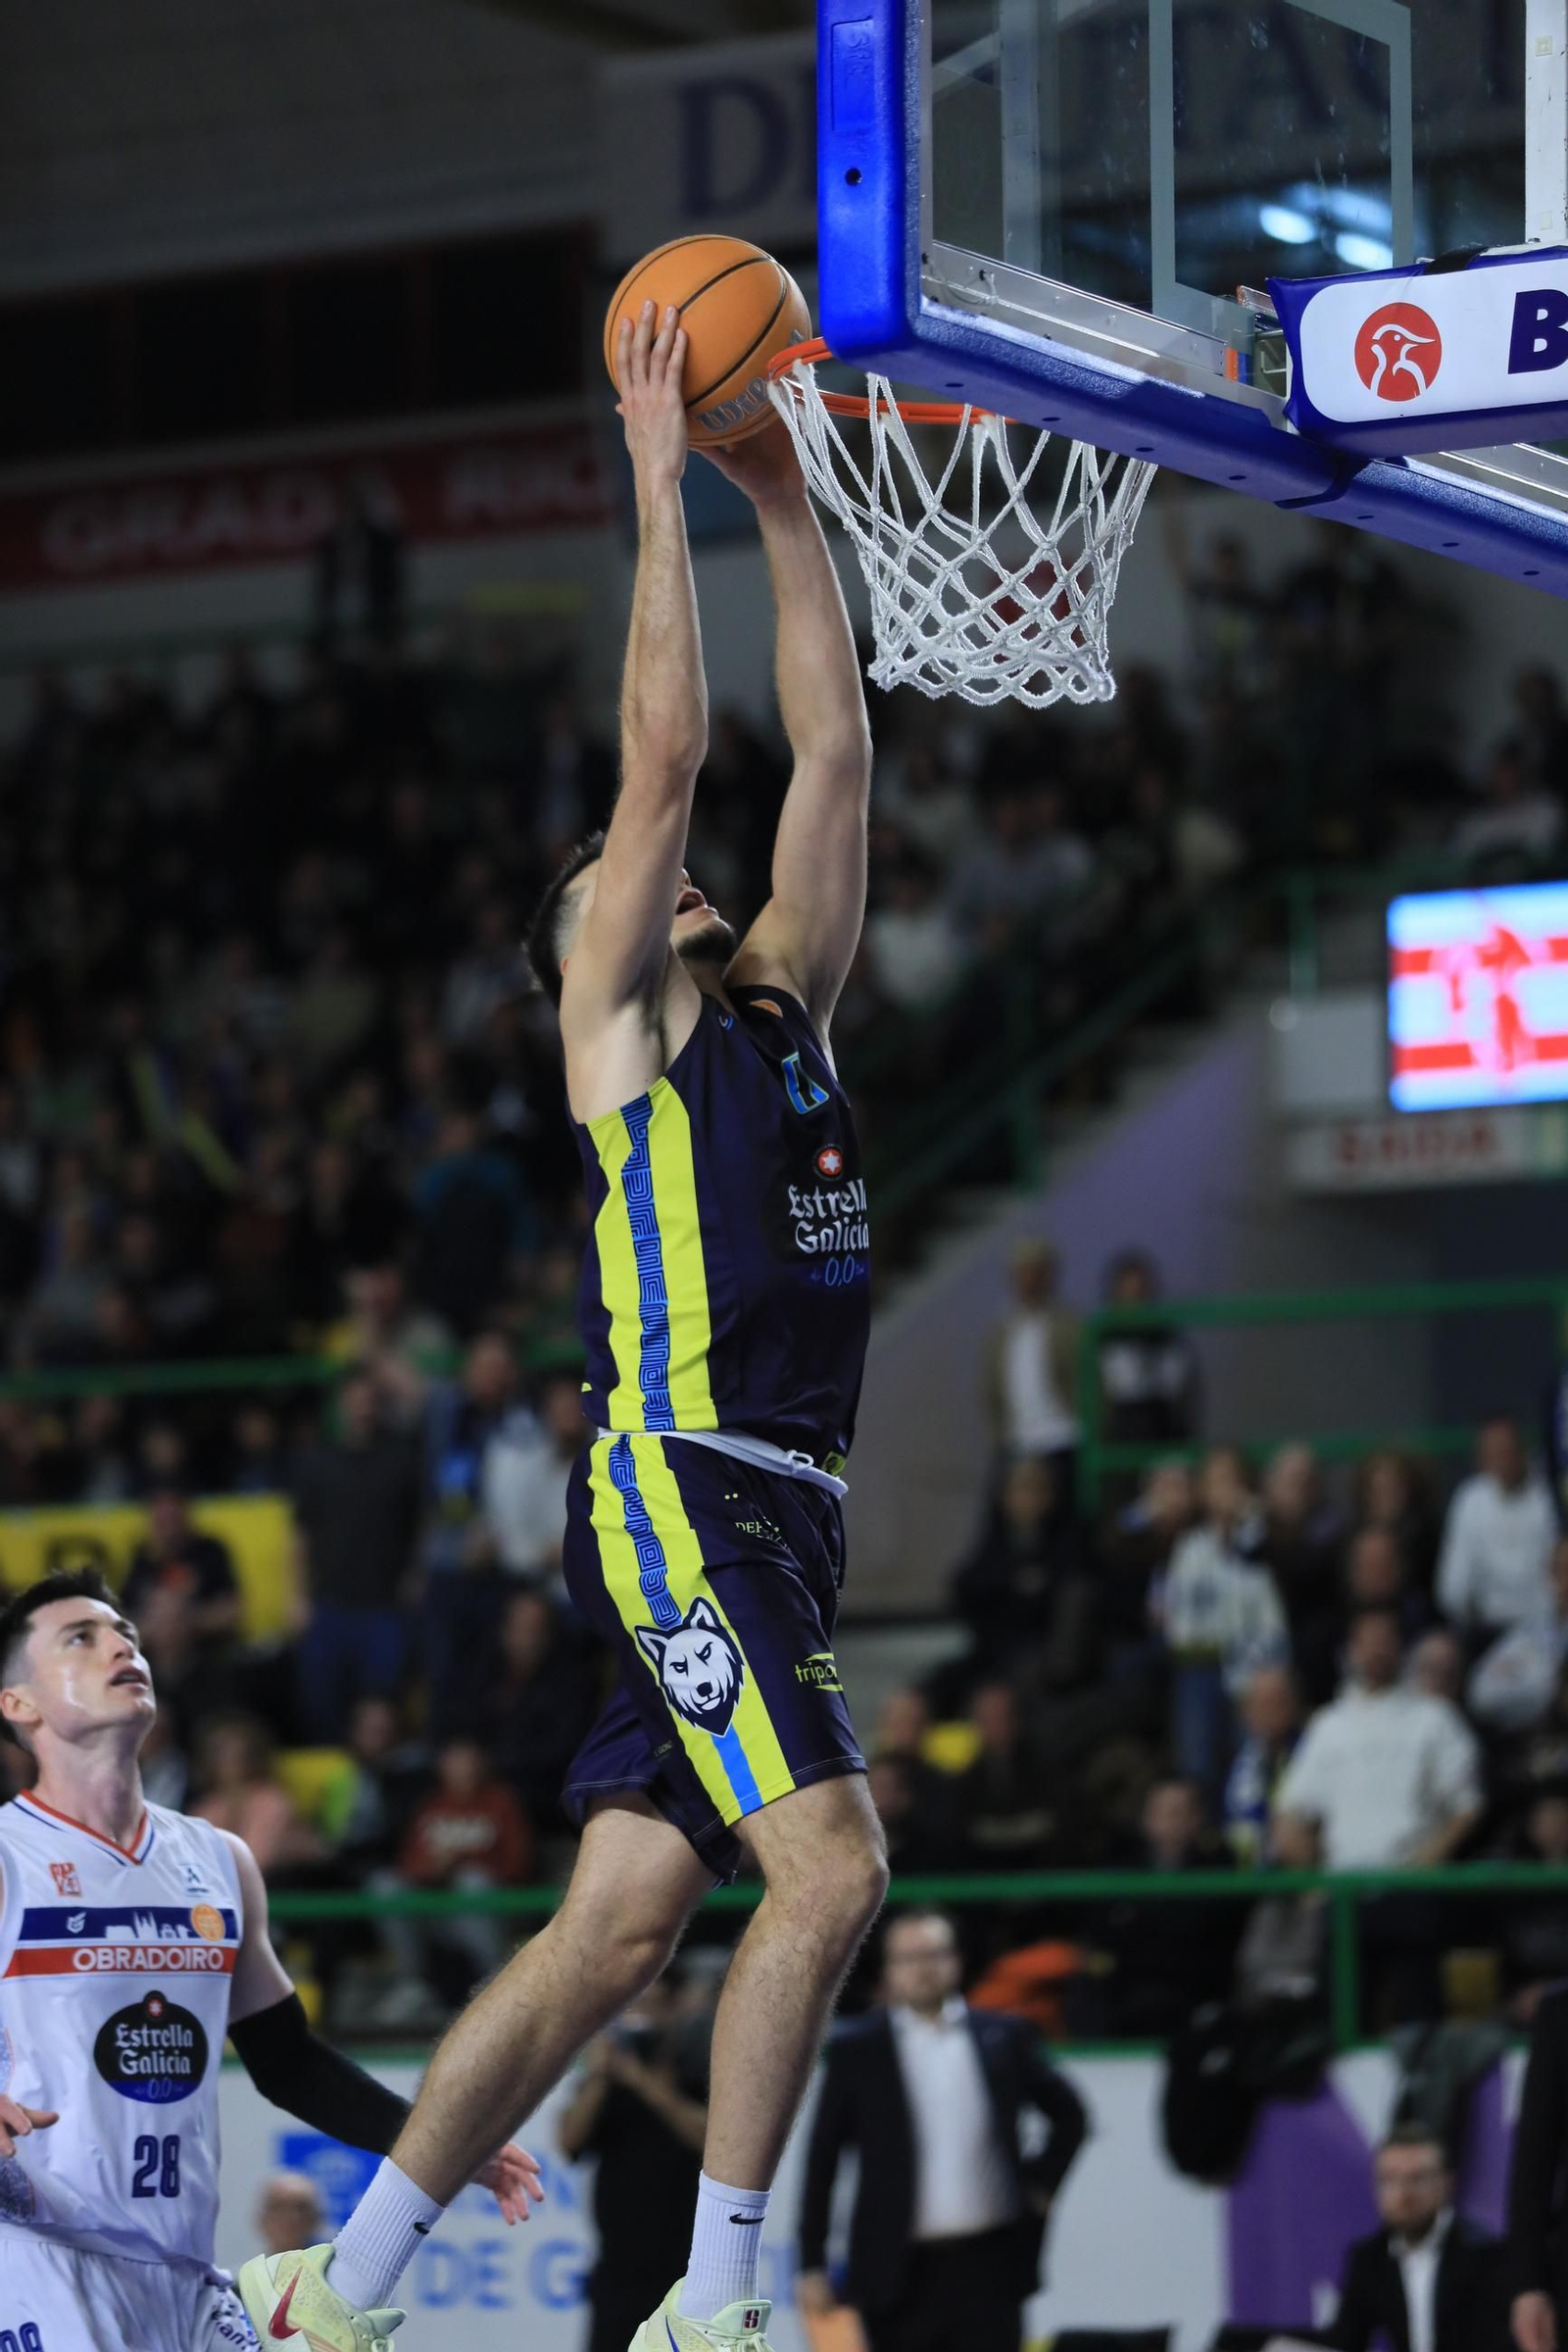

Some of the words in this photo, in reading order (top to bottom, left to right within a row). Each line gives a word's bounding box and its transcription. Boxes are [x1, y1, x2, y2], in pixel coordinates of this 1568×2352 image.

[788, 1178, 867, 1219] Estrell
[73, 1946, 224, 1972] OBRADOIRO
[115, 2023, 194, 2048] Estrella
[119, 2048, 191, 2076] Galicia
[131, 2134, 180, 2198] 28
